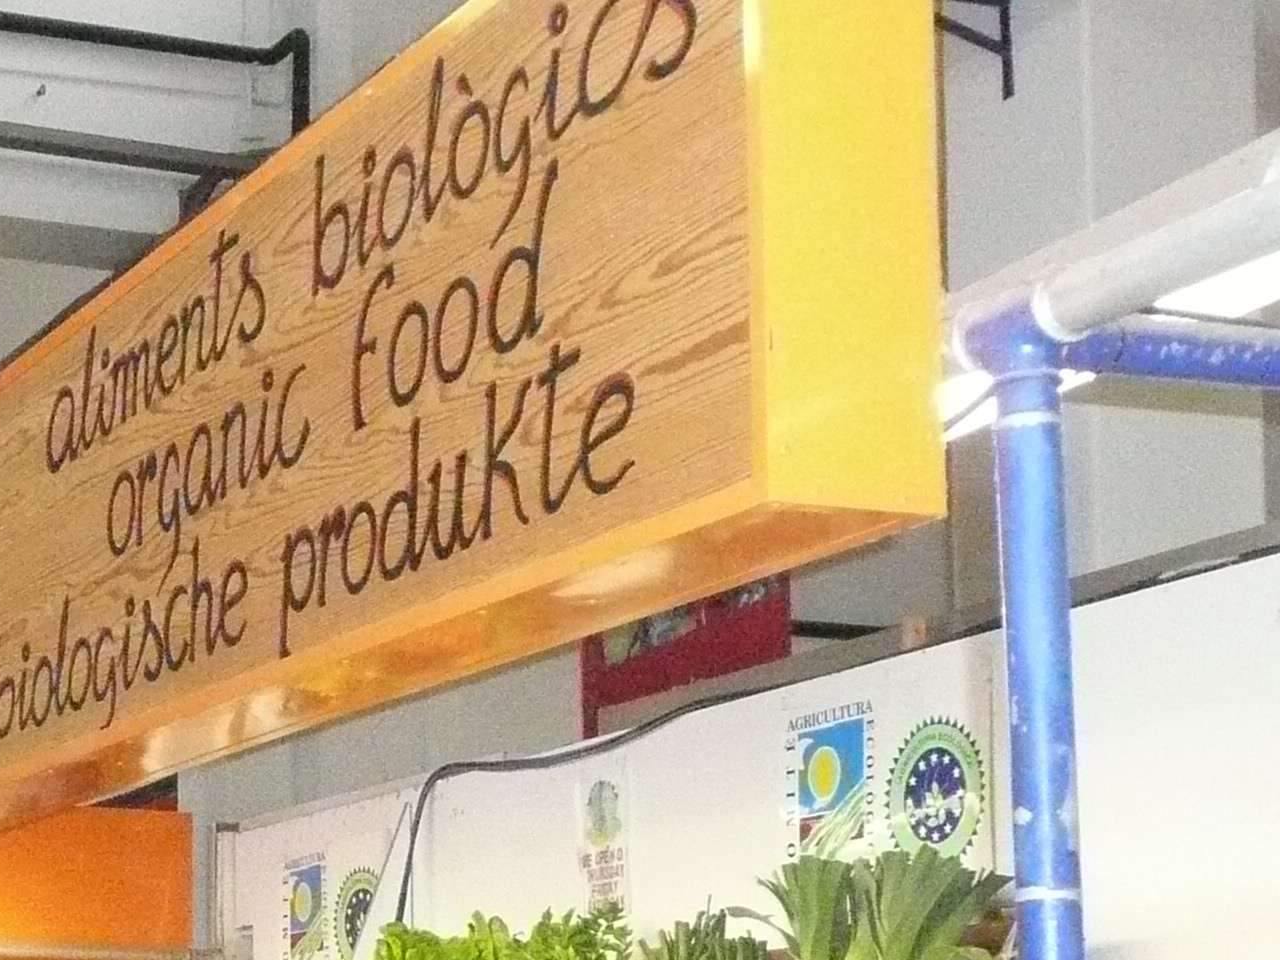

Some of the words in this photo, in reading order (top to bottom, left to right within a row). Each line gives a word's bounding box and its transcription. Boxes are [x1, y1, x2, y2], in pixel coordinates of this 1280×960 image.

[46, 229, 266, 473] aliments
[107, 364, 311, 595] organic
[352, 159, 559, 431] food
[279, 344, 636, 659] produkte
[786, 699, 873, 733] AGRICULTURA
